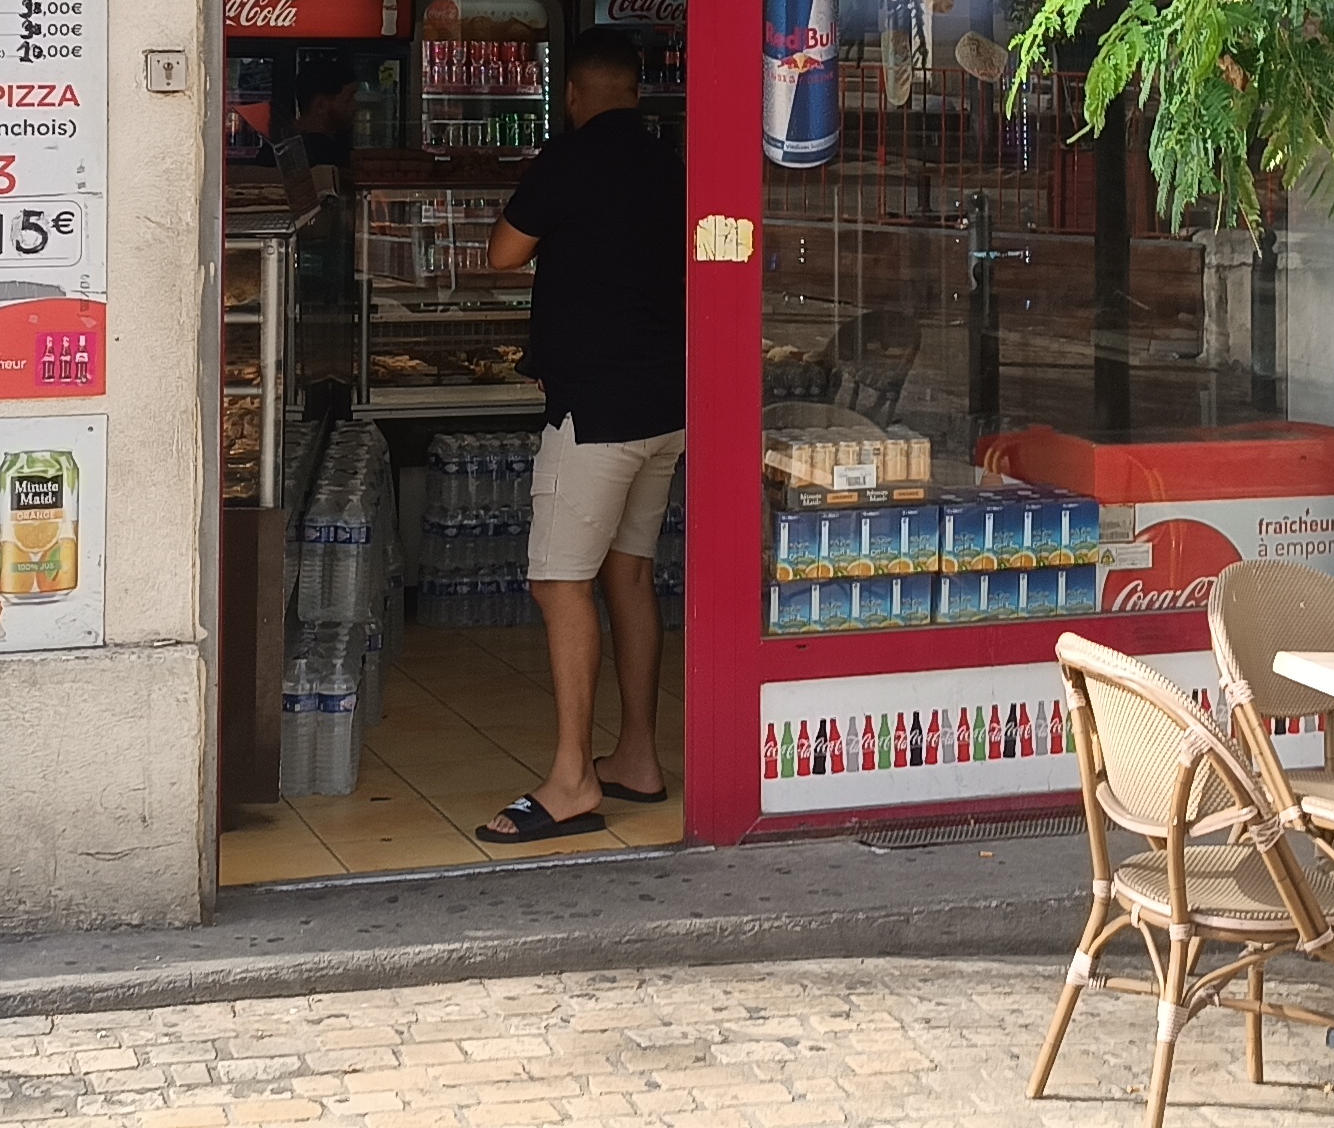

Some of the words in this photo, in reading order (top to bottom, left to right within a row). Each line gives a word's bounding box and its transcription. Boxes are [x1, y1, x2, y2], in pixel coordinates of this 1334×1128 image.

[766, 21, 802, 51] Red
[806, 21, 837, 49] Bull
[1259, 538, 1267, 557] à
